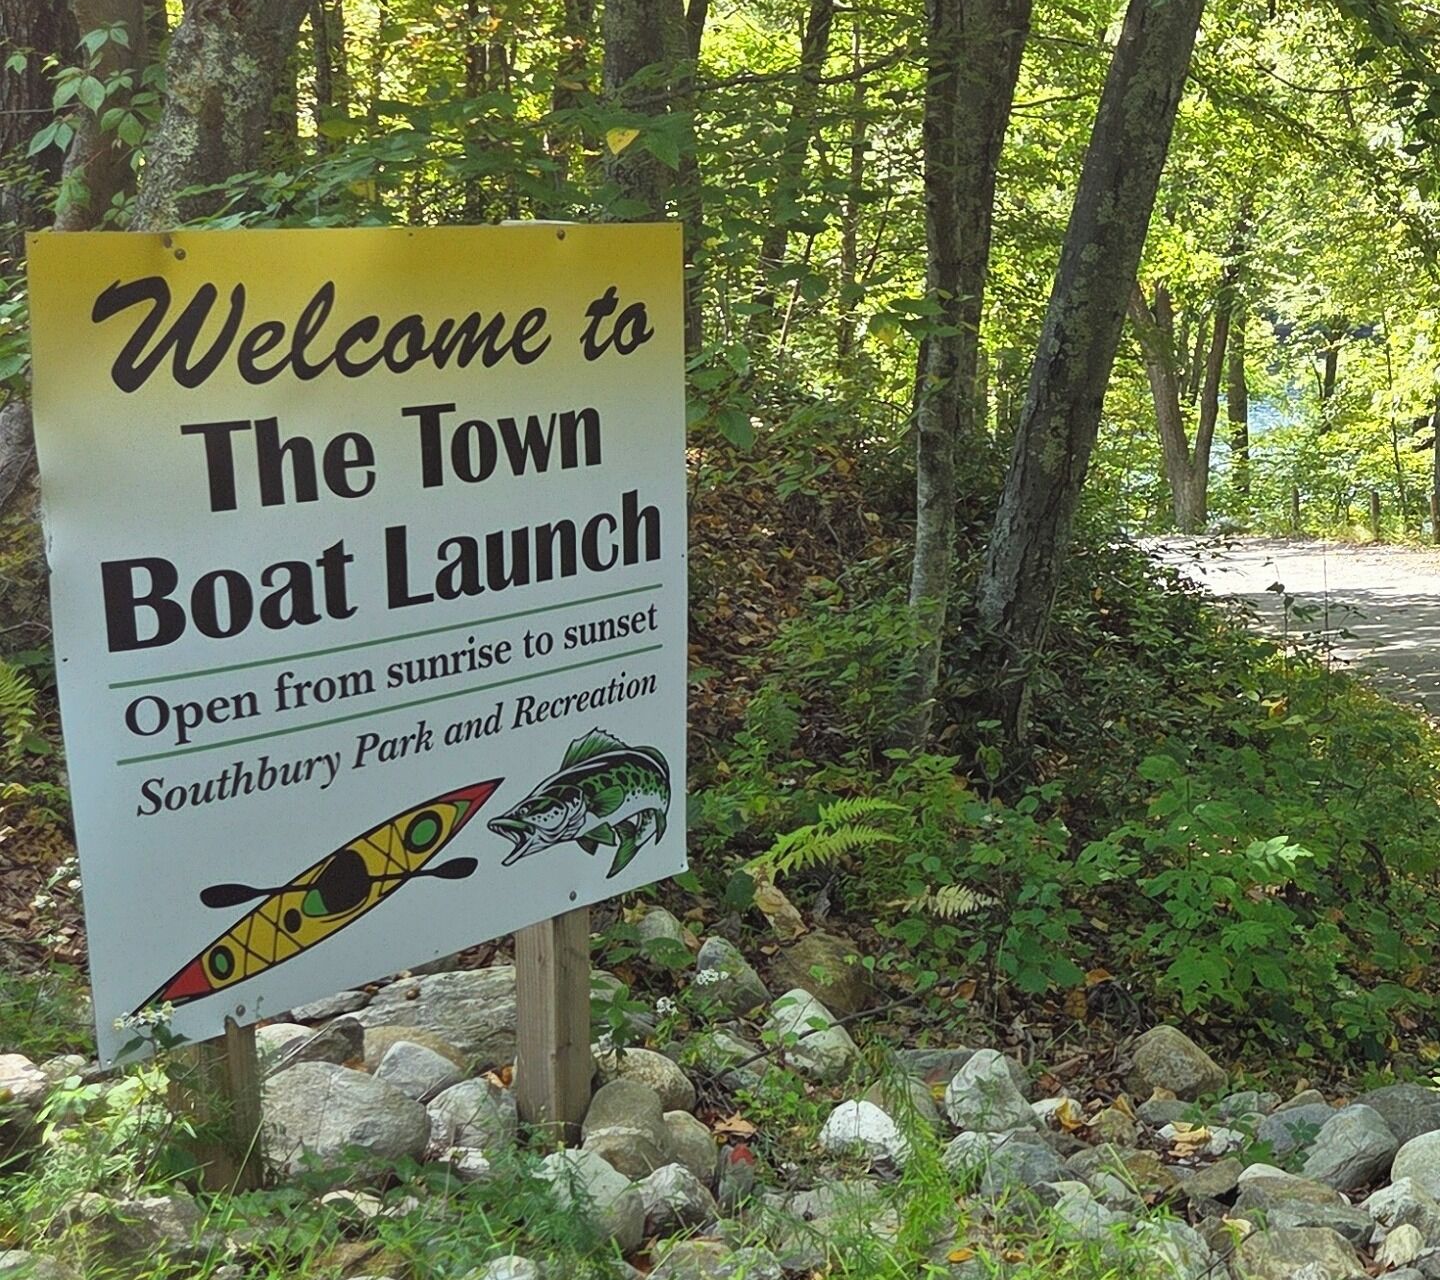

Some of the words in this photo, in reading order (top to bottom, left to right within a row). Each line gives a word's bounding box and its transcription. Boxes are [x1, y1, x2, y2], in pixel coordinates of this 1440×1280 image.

[91, 274, 552, 393] Welcome
[580, 285, 655, 361] to
[181, 416, 375, 512] The
[401, 402, 603, 489] Town
[101, 538, 359, 652] Boat
[385, 489, 662, 610] Launch
[124, 689, 260, 746] Open
[274, 670, 375, 713] from
[387, 639, 513, 690] sunrise
[522, 626, 555, 658] to
[563, 603, 659, 650] sunset
[136, 747, 342, 819] Southbury
[352, 720, 434, 772] Park
[443, 701, 504, 746] and
[511, 669, 658, 731] Recreation
